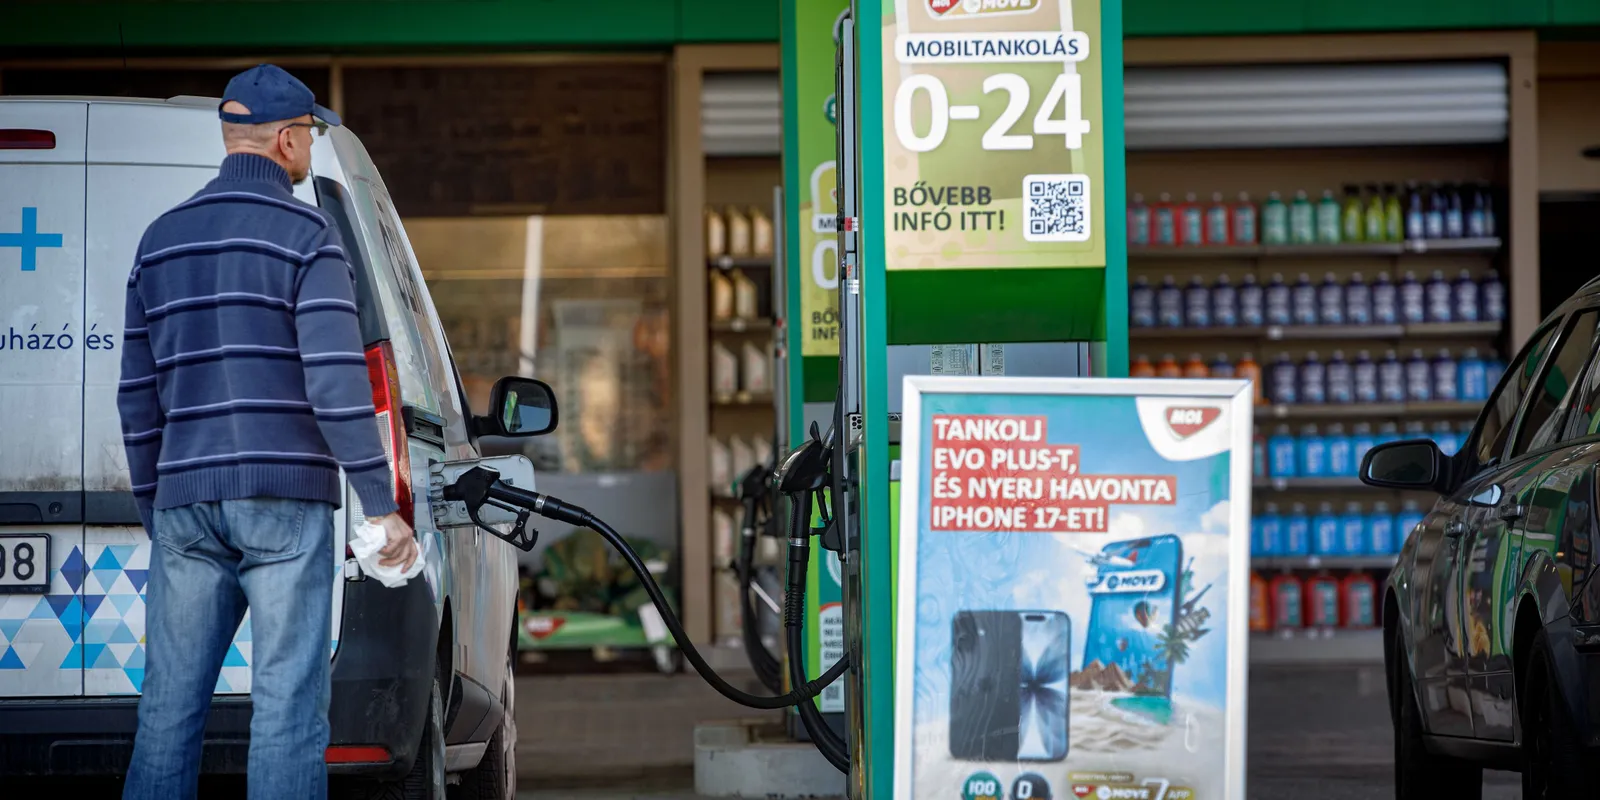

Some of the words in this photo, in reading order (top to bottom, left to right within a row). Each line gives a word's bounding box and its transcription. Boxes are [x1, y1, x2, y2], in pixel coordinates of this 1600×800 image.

[906, 35, 1079, 57] MOBILTANKOLÁS
[894, 73, 1091, 152] 0-24
[893, 181, 993, 207] BŐVEBB
[893, 206, 952, 231] INFÓ
[960, 209, 1005, 231] ITT!
[86, 323, 114, 350] és
[1170, 409, 1204, 425] MOL
[933, 418, 1042, 442] TANKOLJ
[934, 447, 985, 471] EVO
[991, 448, 1077, 474] PLUS-T,
[933, 472, 962, 499] ÉS
[968, 478, 1043, 500] NYERJ
[1051, 478, 1173, 501] HAVONTA
[933, 506, 1026, 529] IPHONE
[1034, 508, 1105, 530] 17-ET!
[0, 543, 35, 581] 8
[1121, 574, 1159, 587] MOVE
[968, 780, 996, 797] 100
[1016, 780, 1033, 799] D
